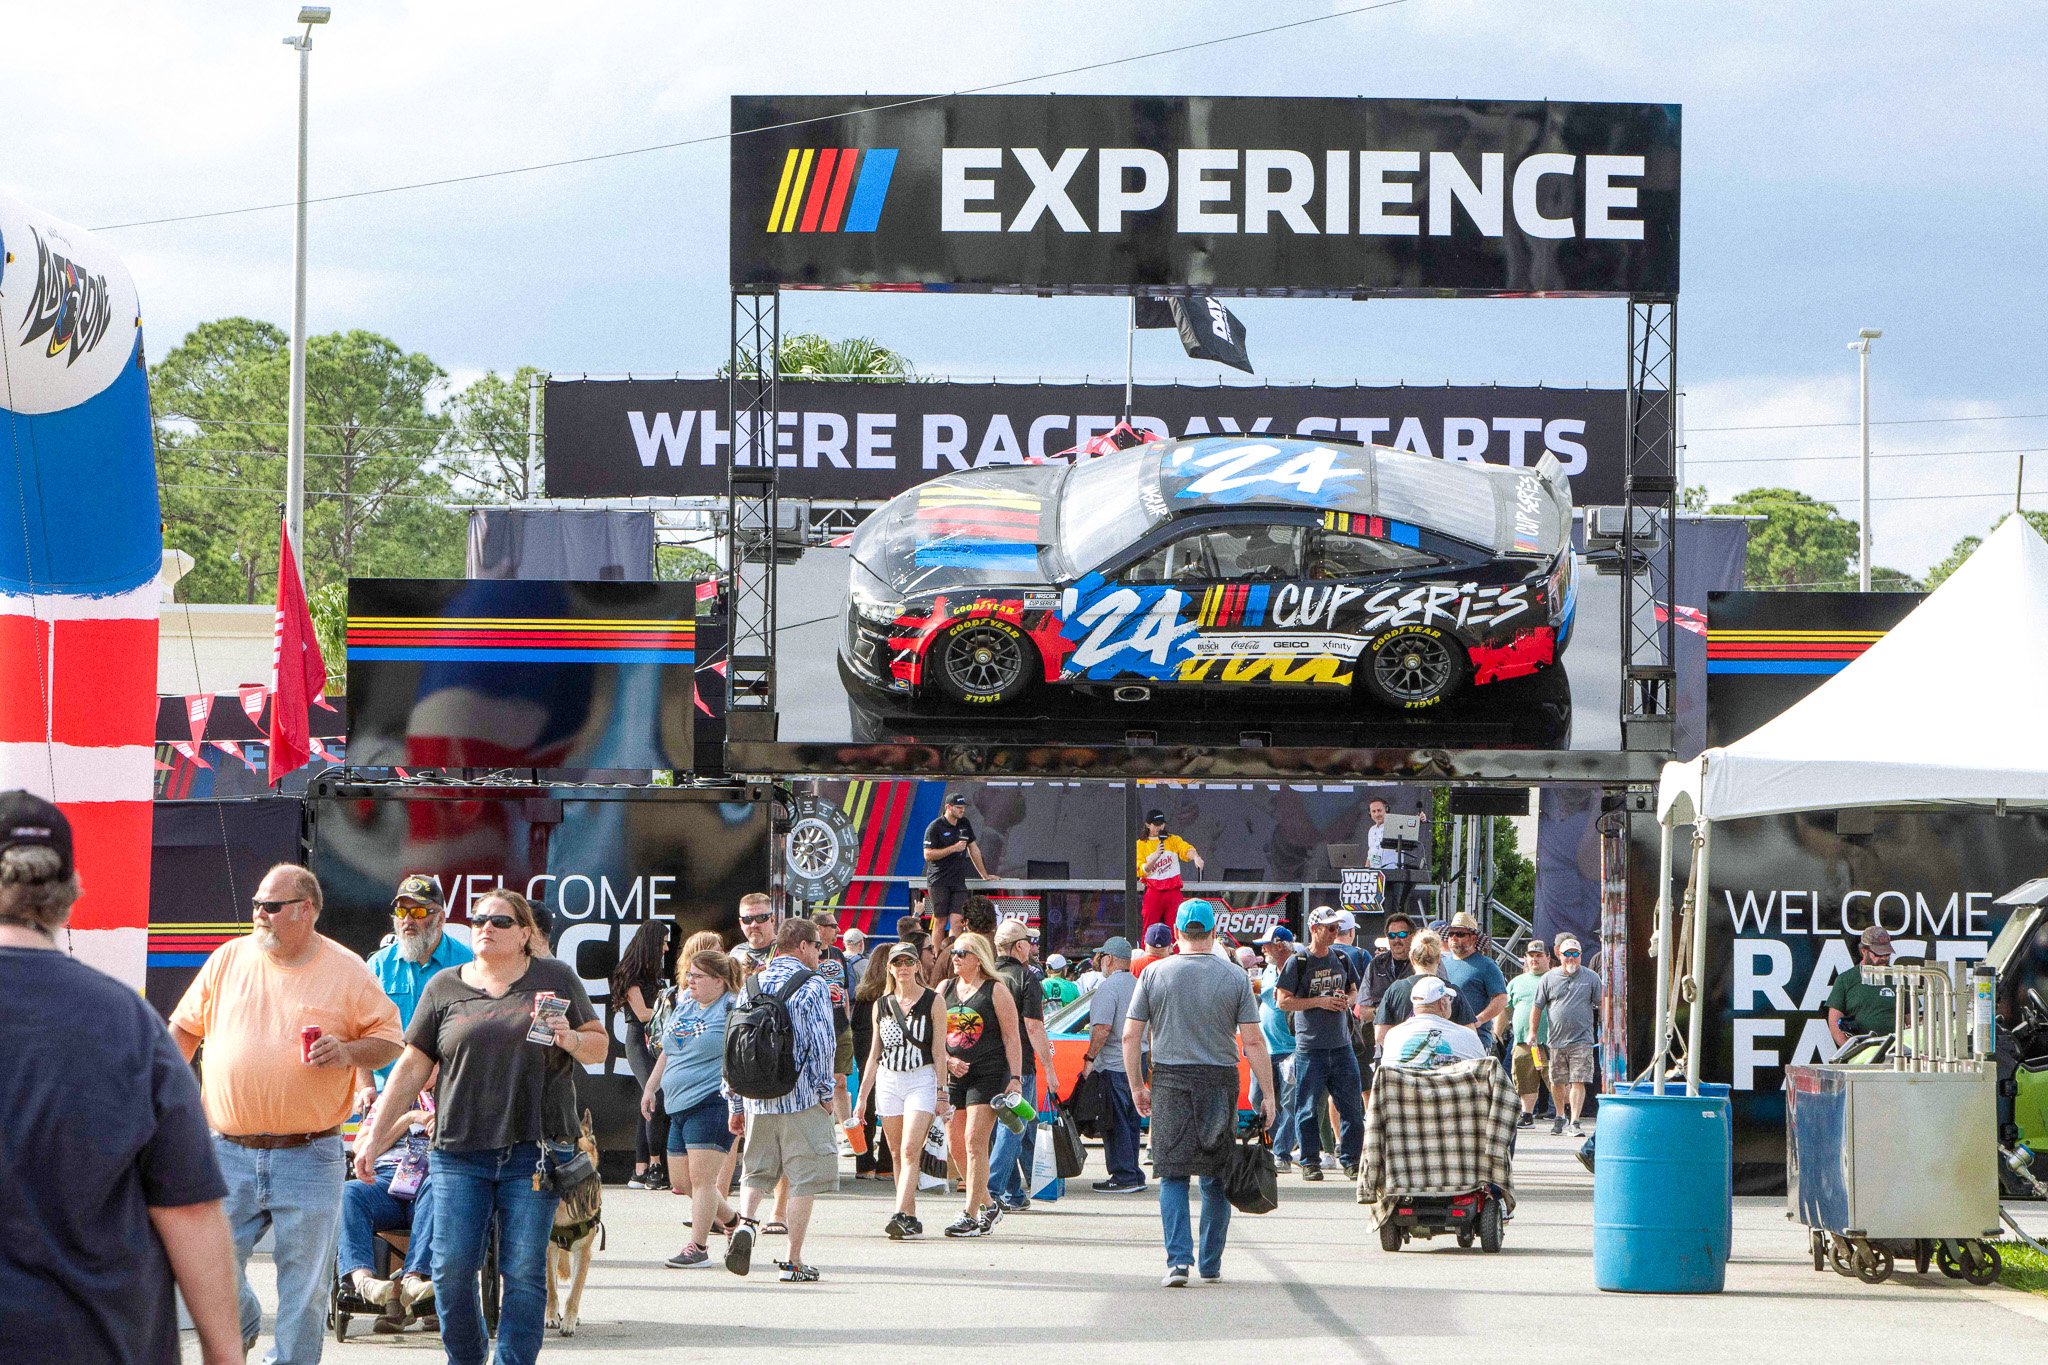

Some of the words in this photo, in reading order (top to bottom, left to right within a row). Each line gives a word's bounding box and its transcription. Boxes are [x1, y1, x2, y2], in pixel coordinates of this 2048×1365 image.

[941, 148, 1645, 240] EXPERIENCE
[627, 410, 897, 470] WHERE
[922, 413, 1273, 471] RACE
[1296, 416, 1588, 476] TARTS
[1515, 475, 1542, 515] SERIES
[1514, 510, 1541, 536] CUP
[953, 599, 1015, 615] GOODYEAR
[1272, 583, 1364, 630] CUP
[1364, 582, 1529, 631] SERIES
[949, 617, 1020, 639] GOODYEAR
[1197, 641, 1219, 651] BUSCH
[1273, 641, 1309, 649] GEICO
[1322, 640, 1352, 652] xfinity
[1372, 625, 1442, 651] GOODYEAR
[963, 692, 1001, 703] EAGLE
[1404, 695, 1440, 709] EAGLE
[1344, 872, 1379, 883] WIDE
[1342, 882, 1378, 894] OPEN
[1342, 893, 1377, 904] TRAX
[1725, 889, 1993, 937] WELCOME
[1314, 969, 1332, 978] INDY
[1309, 973, 1343, 993] 500
